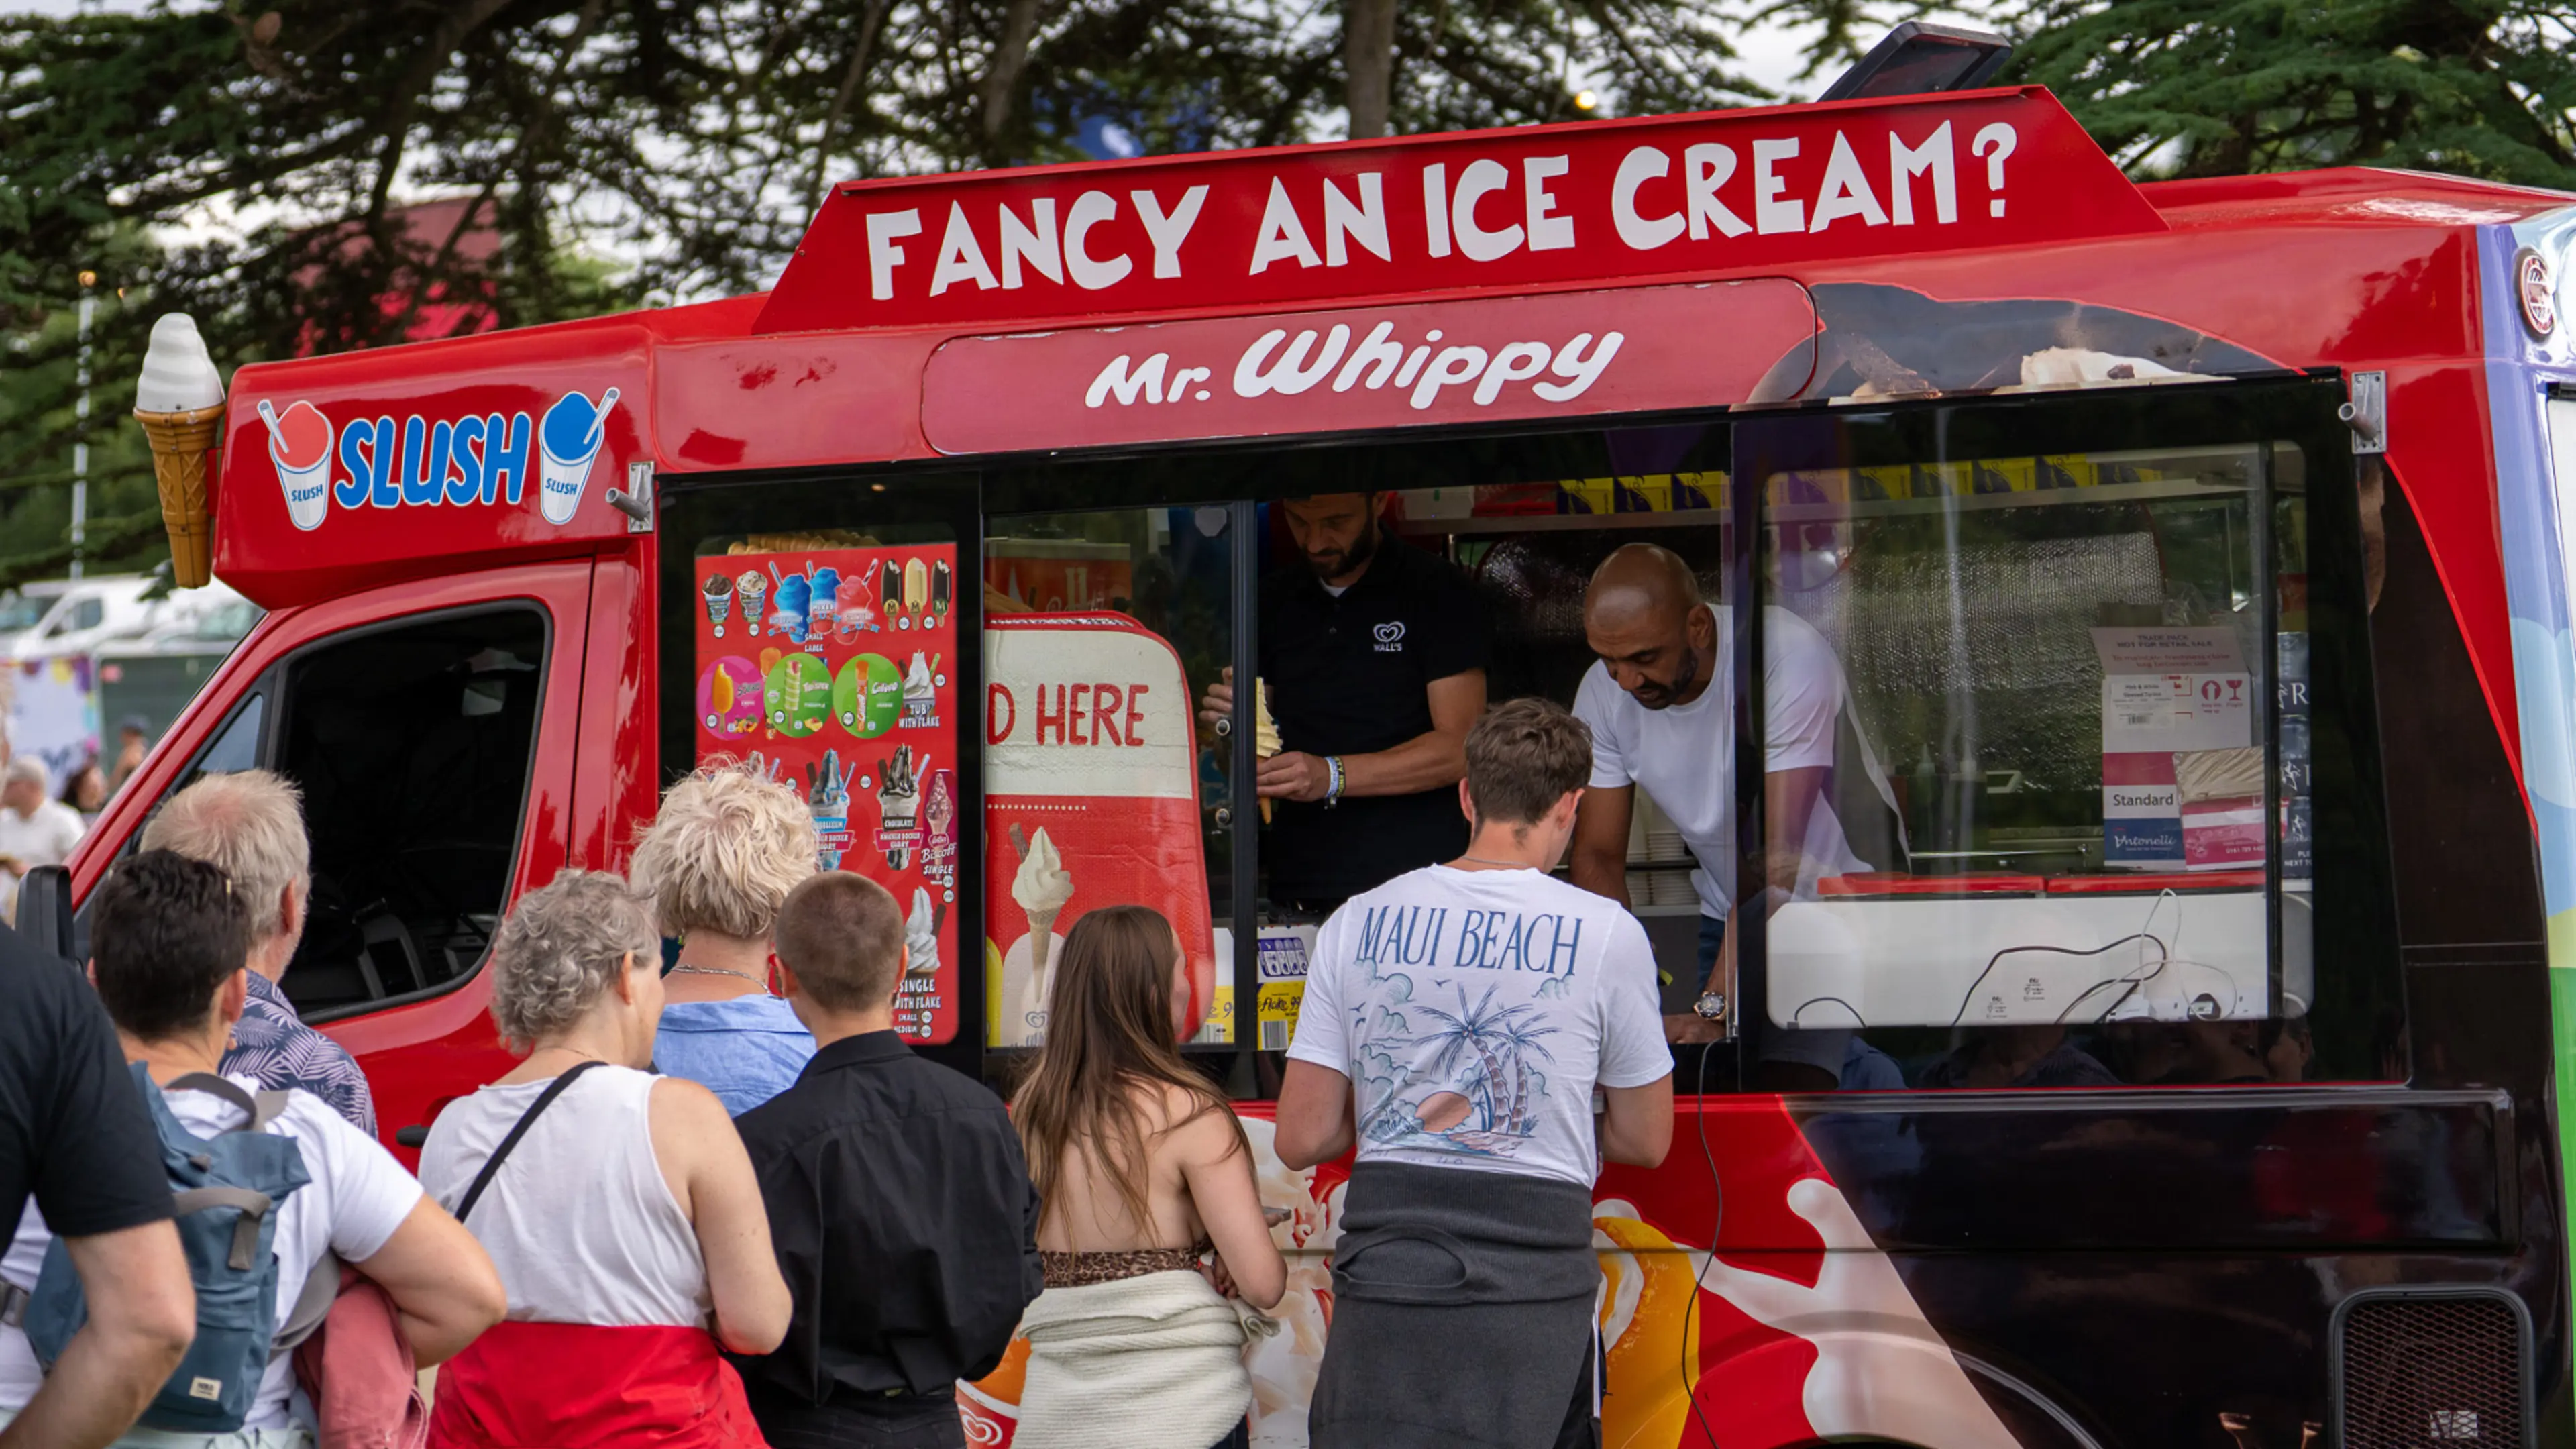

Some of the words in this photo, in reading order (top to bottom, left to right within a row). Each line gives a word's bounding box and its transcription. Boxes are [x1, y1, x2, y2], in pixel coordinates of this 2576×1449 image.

[866, 184, 1210, 301] FANCY
[1249, 172, 1392, 276] AN
[1422, 154, 1576, 262] ICE
[1611, 119, 2018, 251] CREAM?
[1085, 352, 1211, 408] Mr.
[1232, 321, 1625, 409] Whippy
[337, 414, 531, 508] SLUSH
[291, 485, 323, 502] SLUSH
[545, 478, 578, 496] SLUSH
[910, 704, 927, 715] TUB
[1036, 683, 1150, 747] HERE
[898, 717, 916, 728] WITH
[917, 716, 941, 728] FLAKE
[2113, 793, 2174, 806] Standard
[920, 842, 957, 863] Biscoff
[922, 864, 955, 875] SINGLE
[2284, 859, 2304, 867] NEXT
[1356, 905, 1449, 967] MAUI
[1453, 909, 1583, 977] BEACH
[900, 979, 936, 992] SINGLE
[915, 996, 941, 1009] FLAKE
